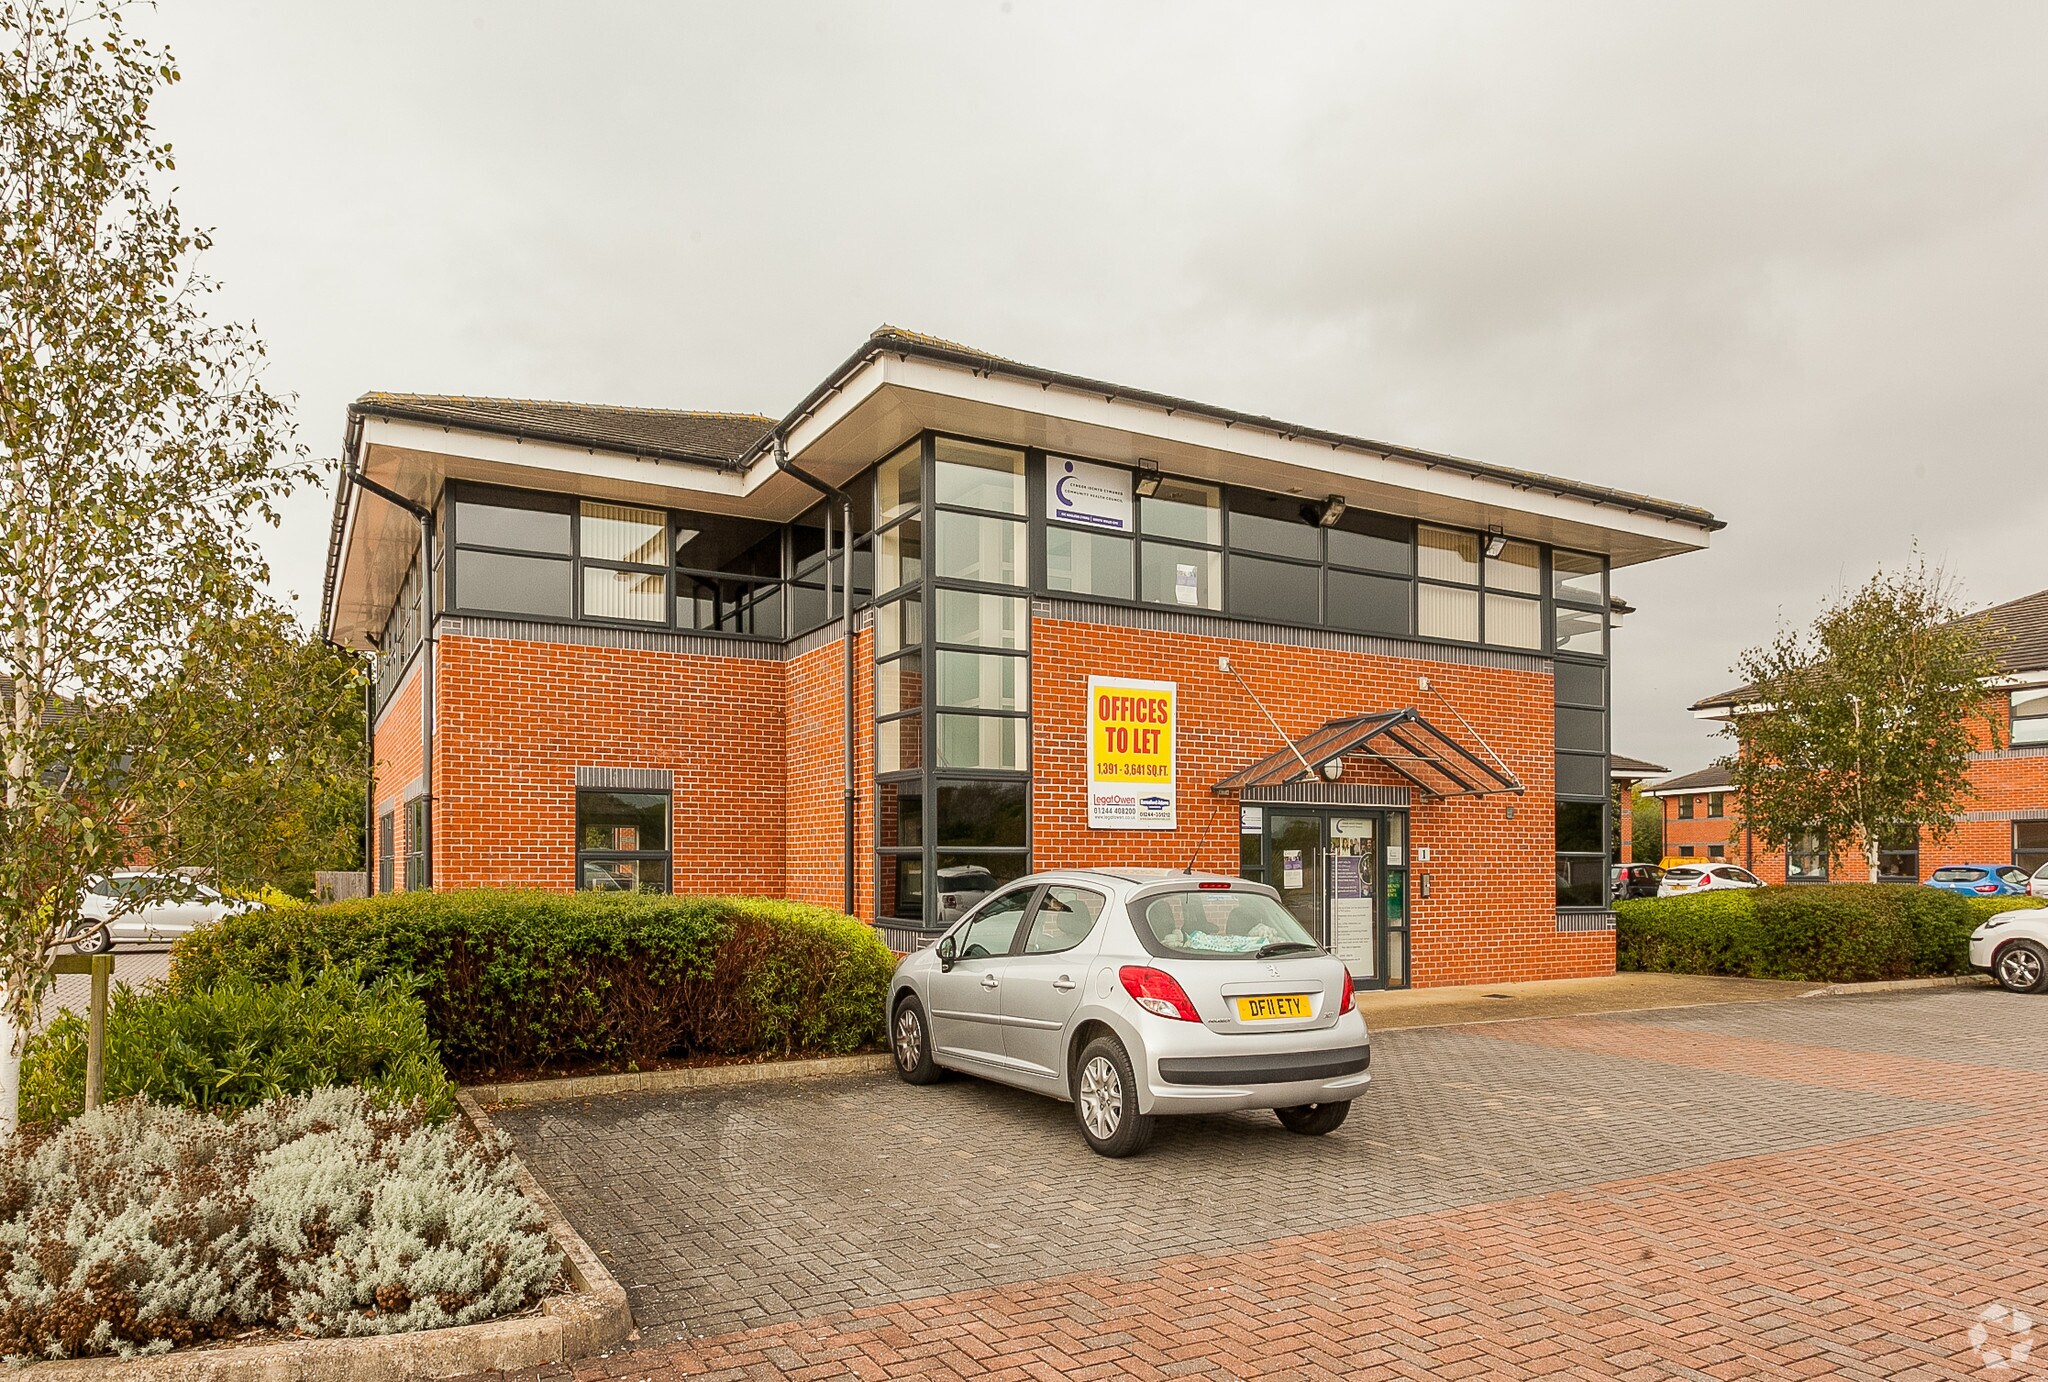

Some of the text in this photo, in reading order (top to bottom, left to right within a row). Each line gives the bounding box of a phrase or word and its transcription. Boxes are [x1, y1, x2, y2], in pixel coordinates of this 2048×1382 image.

[1098, 694, 1168, 725] OFFICES
[1105, 726, 1161, 755] TO LET
[1097, 762, 1118, 776] 1,391
[1124, 763, 1145, 777] 3,641
[1093, 807, 1137, 815] 01244 408200
[1248, 998, 1301, 1017] DF11 ETY
